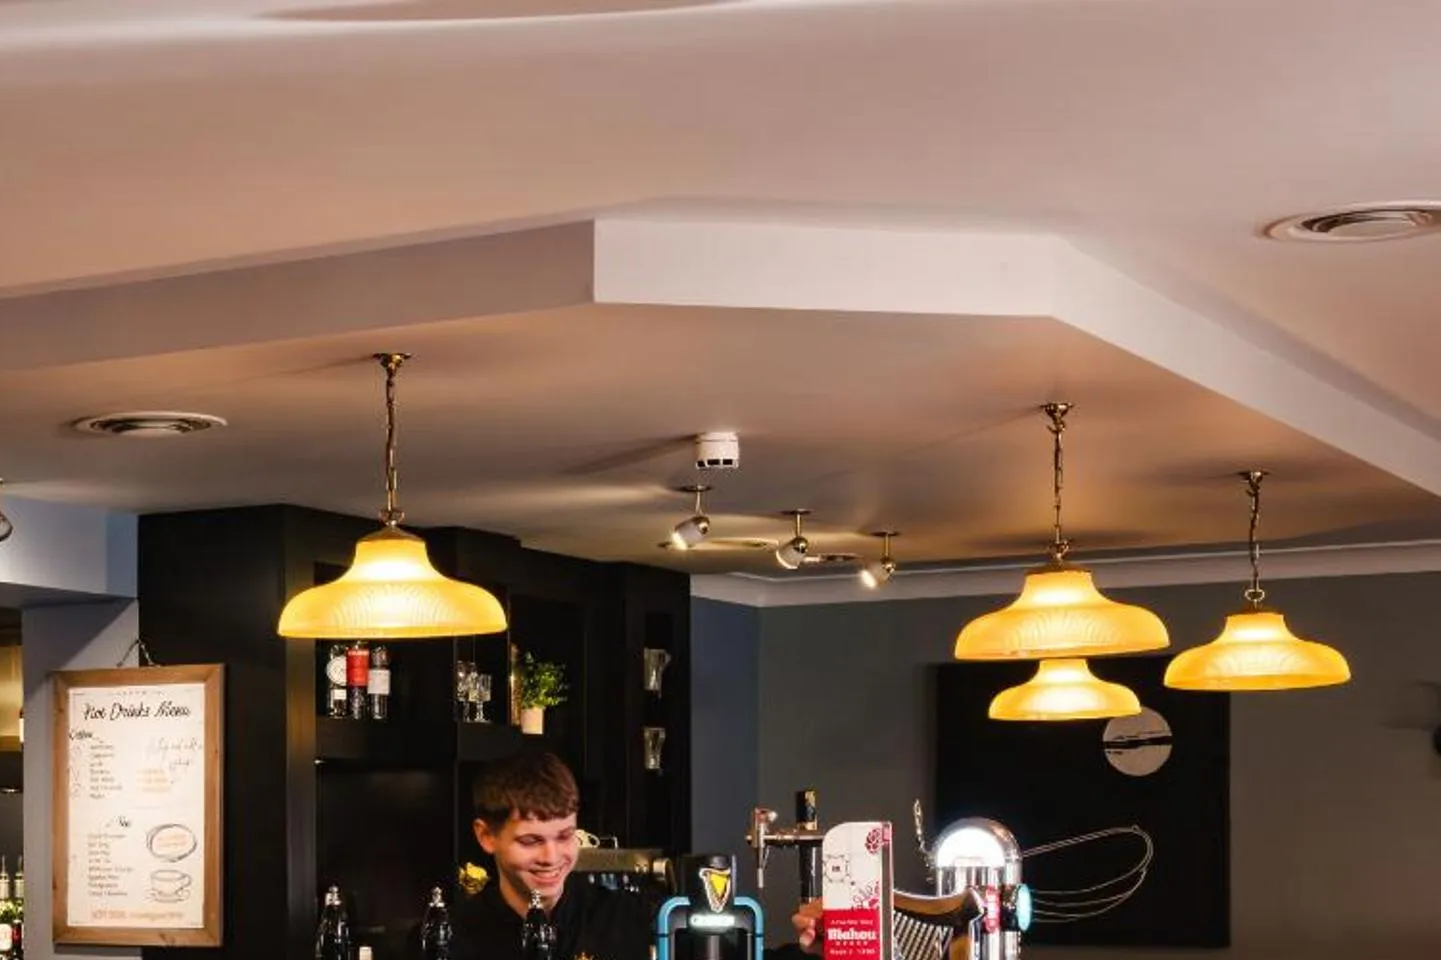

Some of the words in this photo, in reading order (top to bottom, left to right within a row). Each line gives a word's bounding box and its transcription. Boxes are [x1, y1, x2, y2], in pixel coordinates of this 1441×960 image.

[110, 701, 151, 720] Drinks
[154, 700, 191, 718] Menu
[827, 927, 877, 940] Mahou
